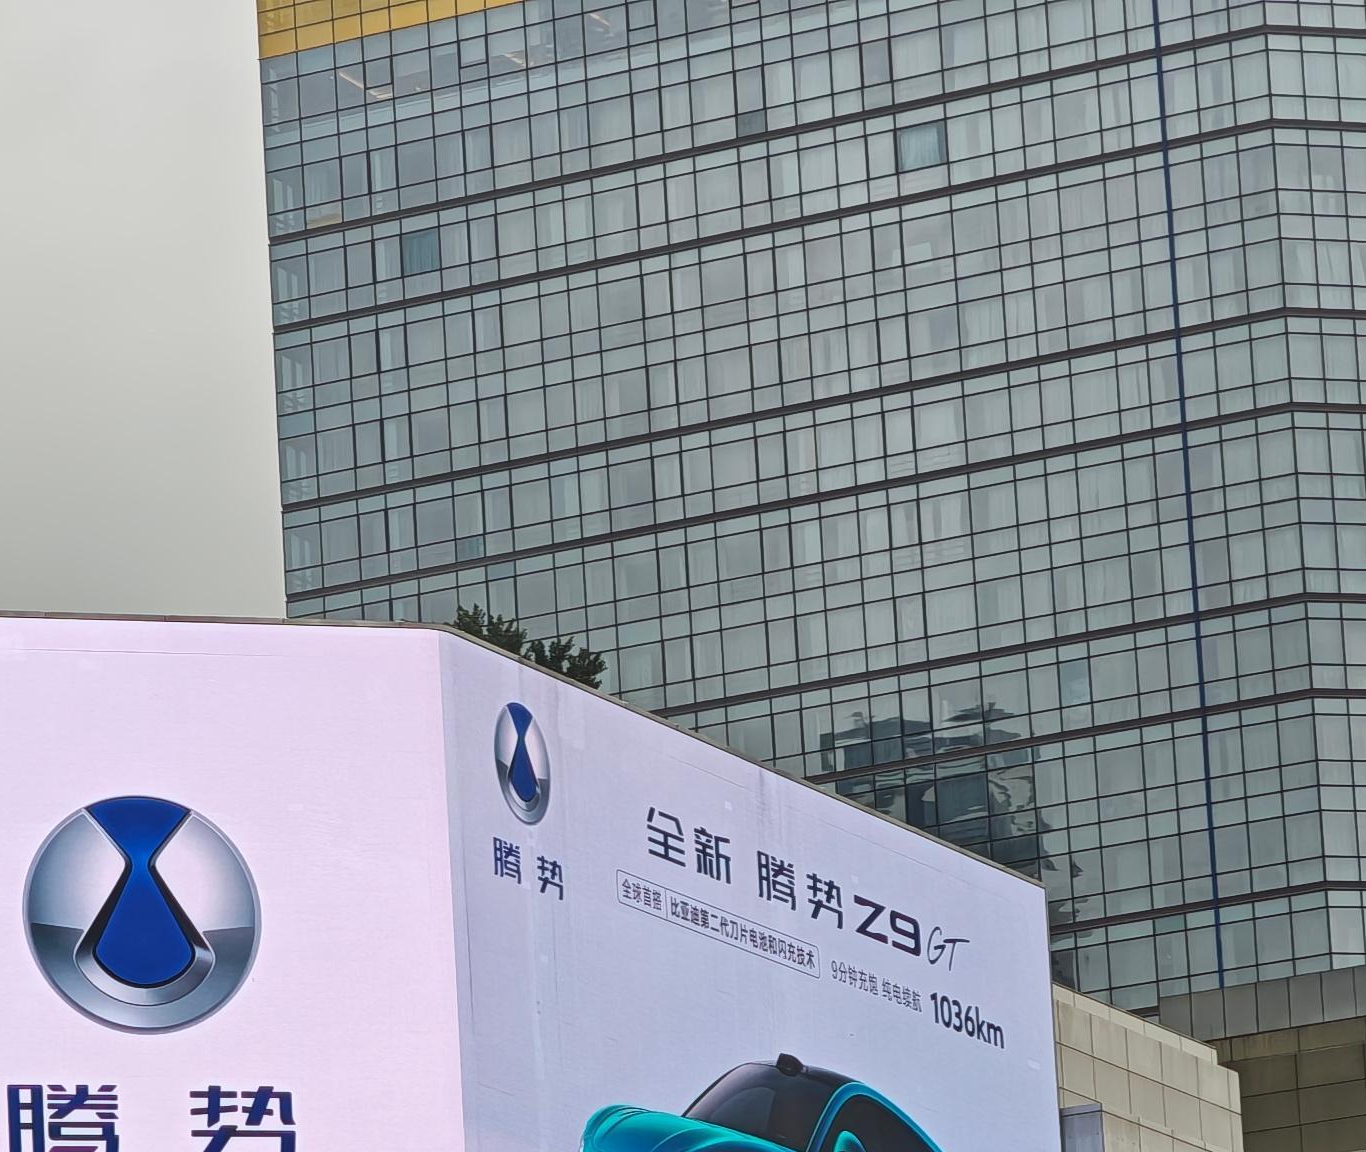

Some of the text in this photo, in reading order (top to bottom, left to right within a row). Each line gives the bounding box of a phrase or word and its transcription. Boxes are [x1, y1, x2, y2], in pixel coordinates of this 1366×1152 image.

[492, 837, 564, 901] 腾势
[646, 806, 732, 885] 全新
[930, 992, 1005, 1050] 1036km
